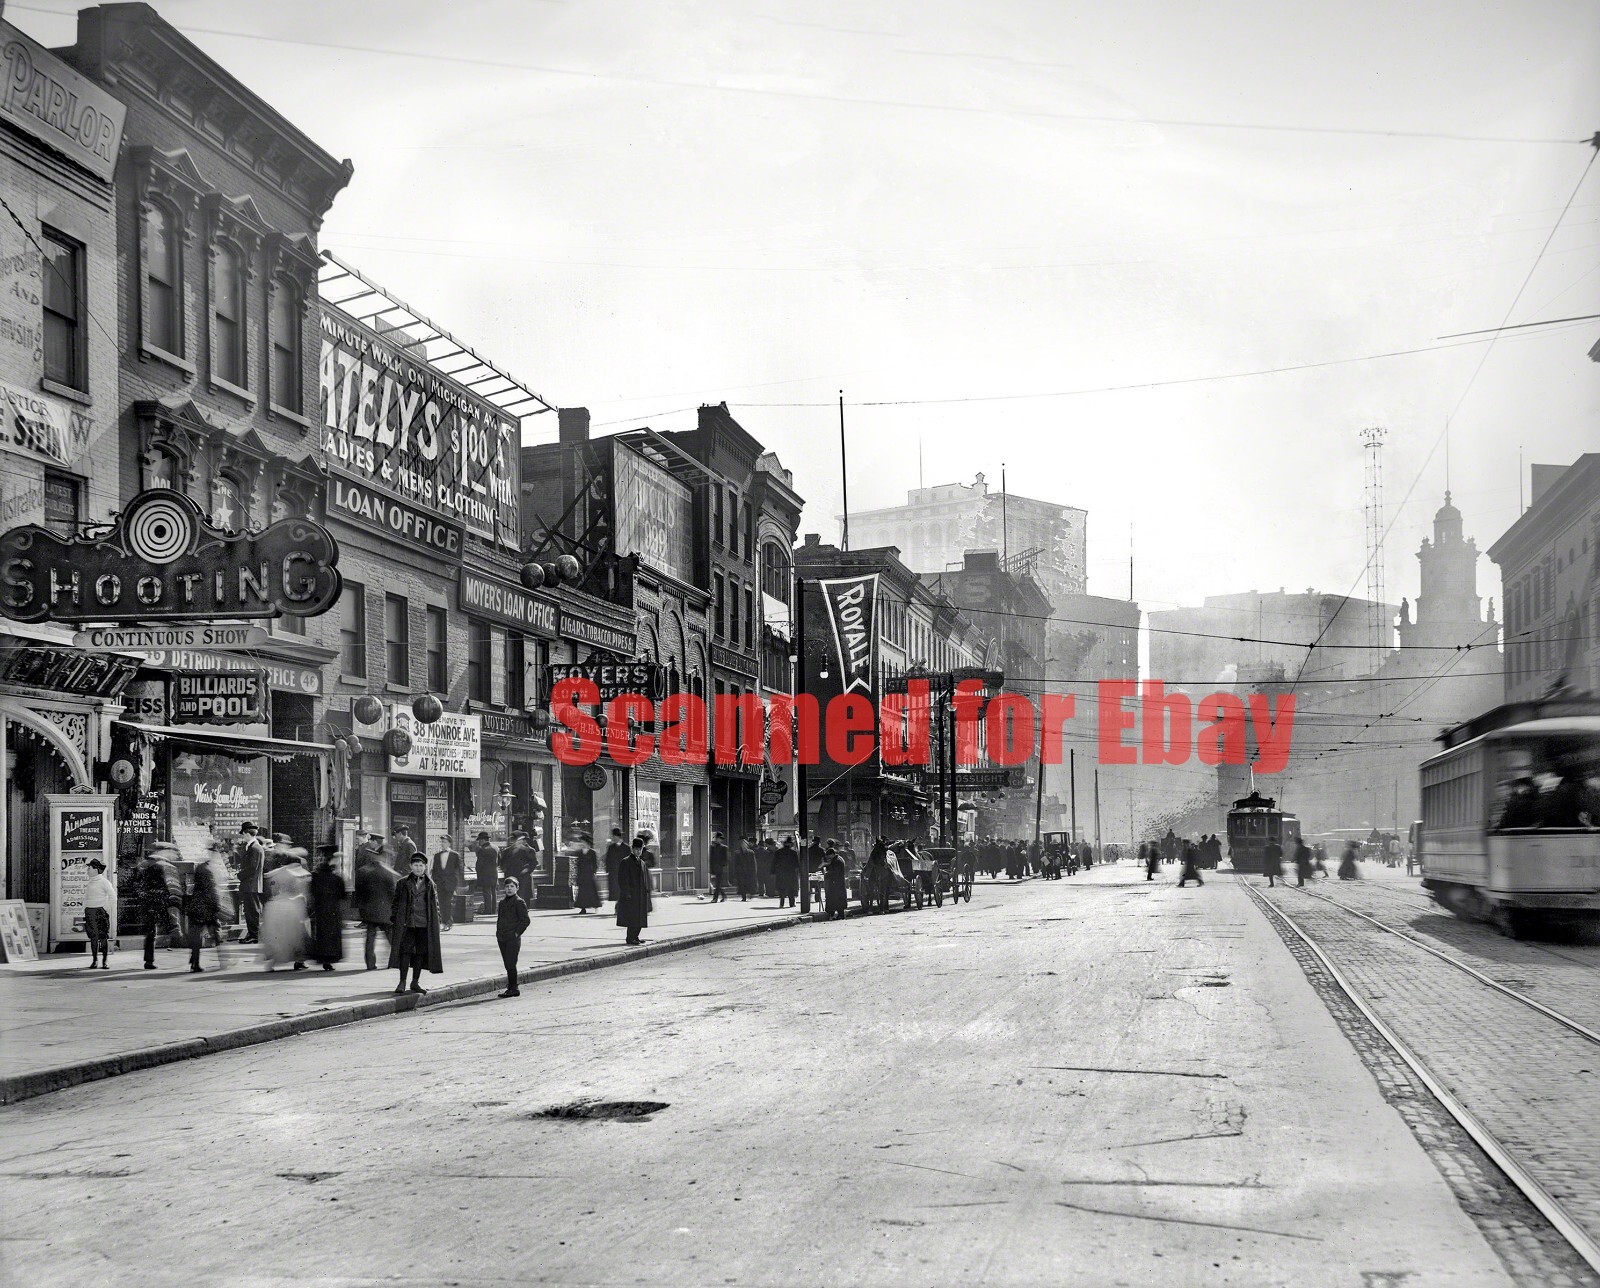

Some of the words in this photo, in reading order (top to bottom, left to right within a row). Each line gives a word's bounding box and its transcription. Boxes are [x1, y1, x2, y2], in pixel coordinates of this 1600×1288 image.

[4, 38, 116, 163] PARLOR
[320, 312, 368, 355] MINUTE
[371, 342, 403, 377] WALK
[408, 366, 424, 389] ON
[431, 375, 480, 419] MICHIGAN
[381, 458, 393, 482] &
[335, 480, 384, 525] LOAN
[389, 504, 459, 552] OFFICE
[4, 551, 317, 608] SHOOTING
[466, 576, 501, 612] MOYER'S
[504, 590, 525, 623] LOAN
[90, 629, 195, 648] CONTINUOUS
[202, 628, 251, 646] SHOW
[837, 582, 870, 674] ROYALE
[591, 652, 610, 663] 42
[170, 651, 223, 671] DETROIT
[302, 676, 317, 690] 46
[552, 664, 649, 685] MOYER'S
[180, 677, 257, 695] BILLIARDS
[600, 686, 649, 699] OFFICE
[180, 701, 197, 712] AND
[199, 697, 258, 716] POOL
[413, 720, 426, 737] 38
[427, 724, 462, 741] MONROE
[484, 714, 515, 733] MOYER'S
[419, 757, 429, 770] AT
[230, 785, 250, 809] Office
[64, 815, 100, 837] ALHAMBRA
[151, 812, 157, 820] &
[66, 834, 99, 844] ADMISSION
[134, 826, 153, 834] SALE
[61, 856, 88, 871] OPEN
